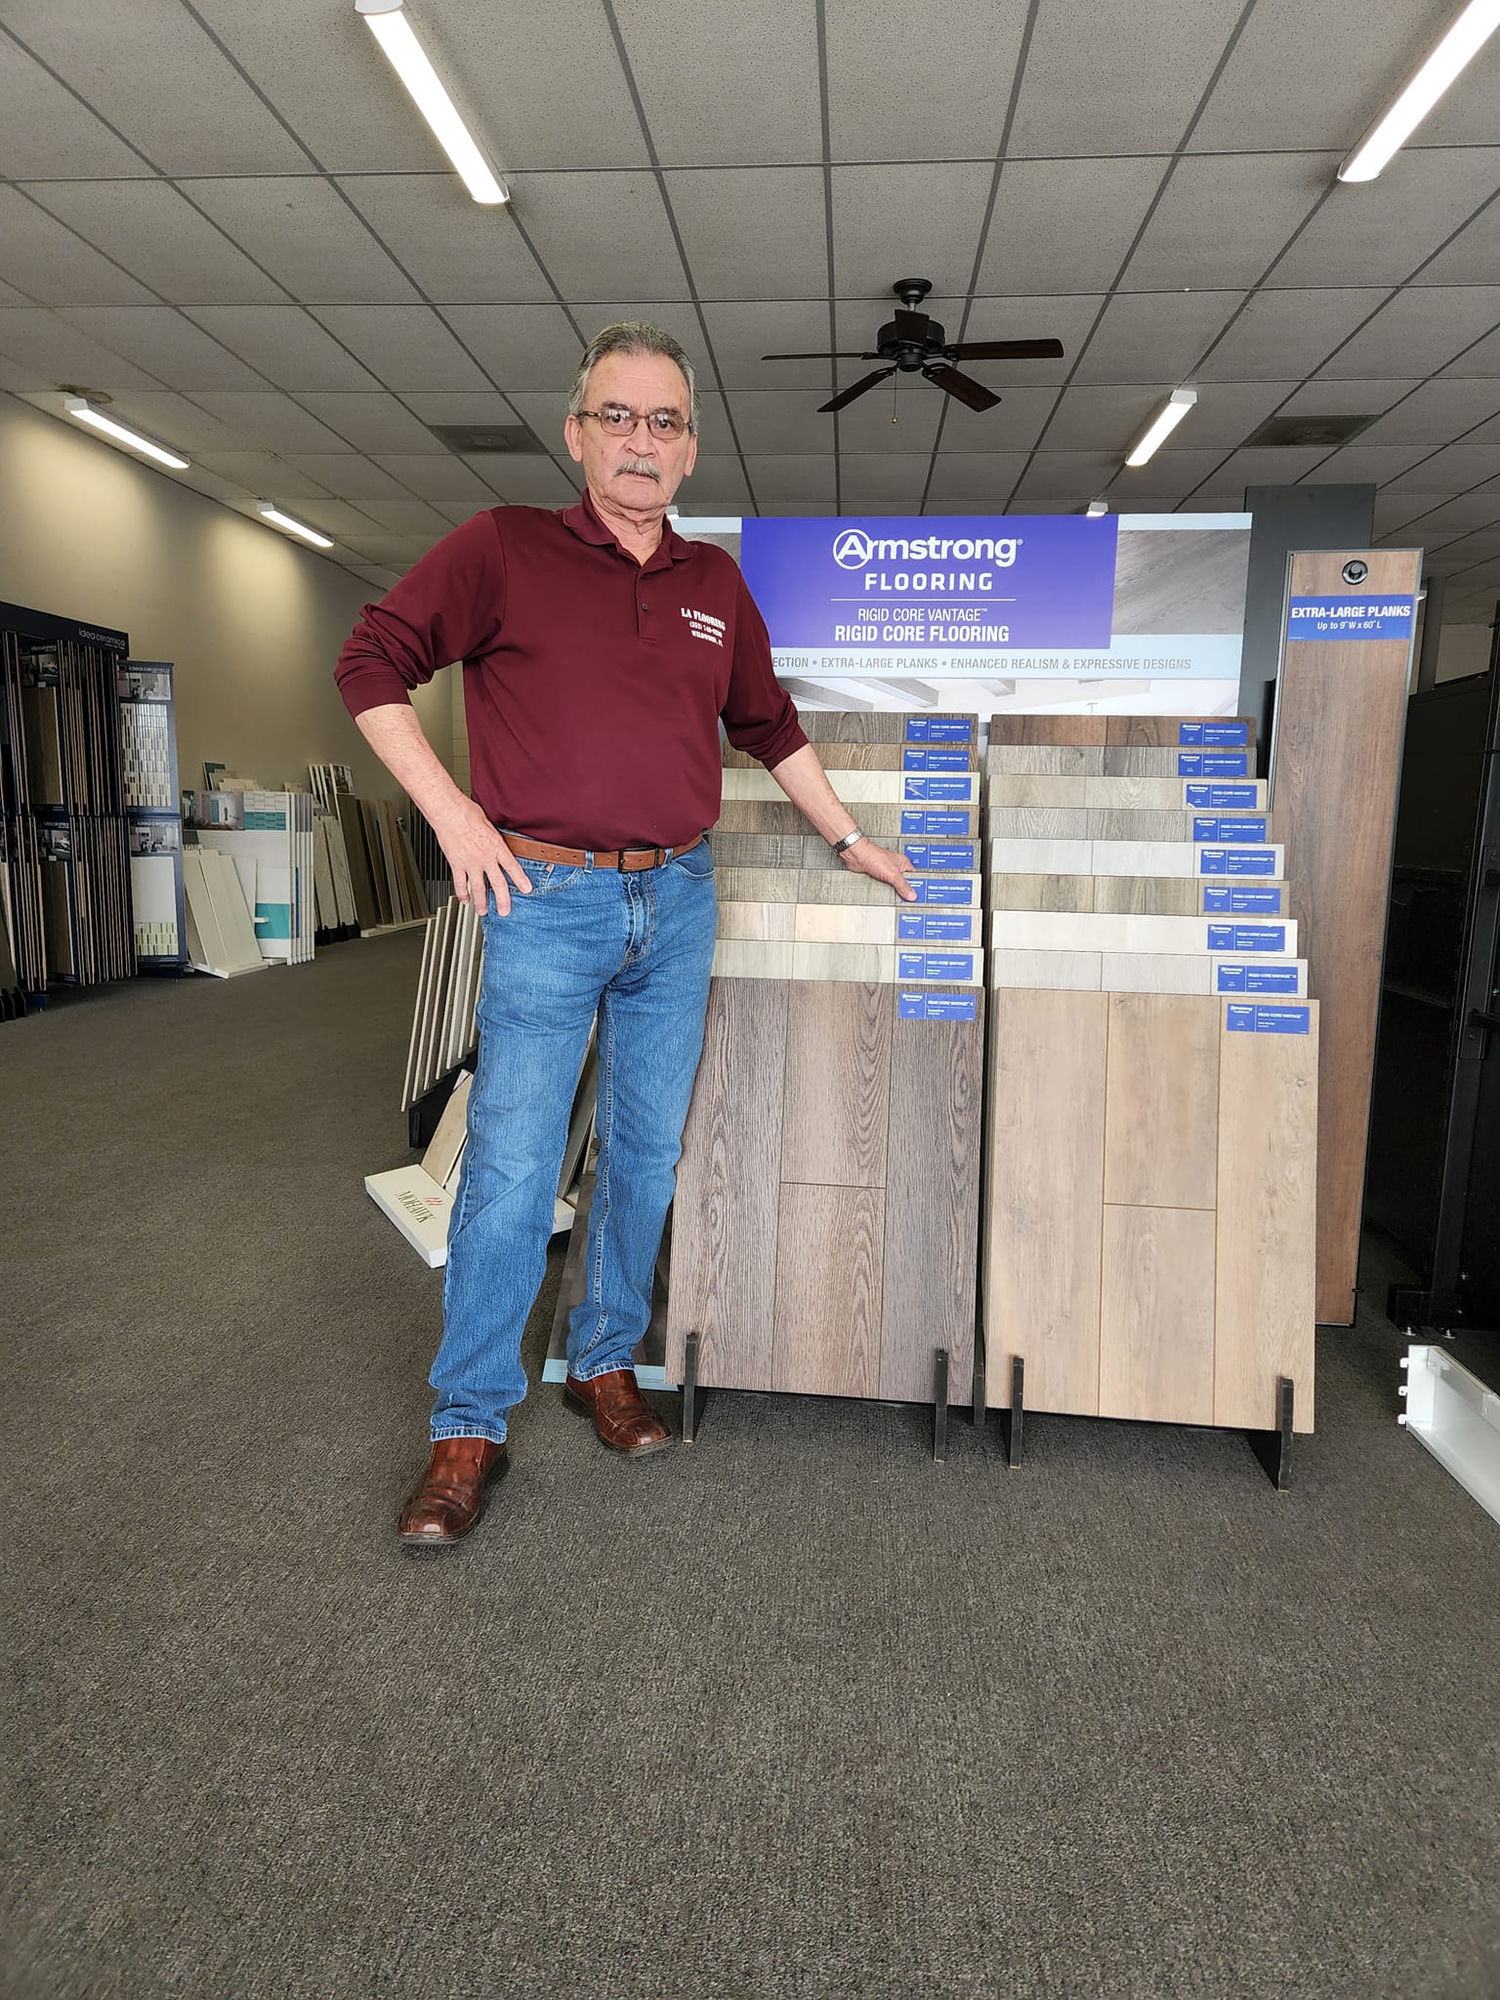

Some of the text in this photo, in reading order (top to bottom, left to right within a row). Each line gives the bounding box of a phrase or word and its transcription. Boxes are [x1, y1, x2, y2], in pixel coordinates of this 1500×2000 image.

[865, 573, 993, 591] FLOORING
[681, 607, 692, 619] LA
[858, 608, 889, 622] RIGID
[893, 608, 925, 622] CORE
[1291, 605, 1411, 618] EXTRA-LARGE PLANKS
[1317, 621, 1328, 631] Up
[1330, 621, 1338, 629] to
[1377, 620, 1382, 629] L
[834, 625, 1010, 643] RIGID CORE FLOORING
[821, 657, 896, 669] EXTRA-LARGE
[896, 657, 938, 669] PLANKS
[950, 658, 1008, 669] ENHANCED
[1011, 658, 1059, 670] REALISM
[1062, 658, 1070, 669] &
[1073, 659, 1140, 670] EXPRESSIVE
[1143, 659, 1192, 670] DESIGNS
[395, 1190, 436, 1223] MOHAWK
